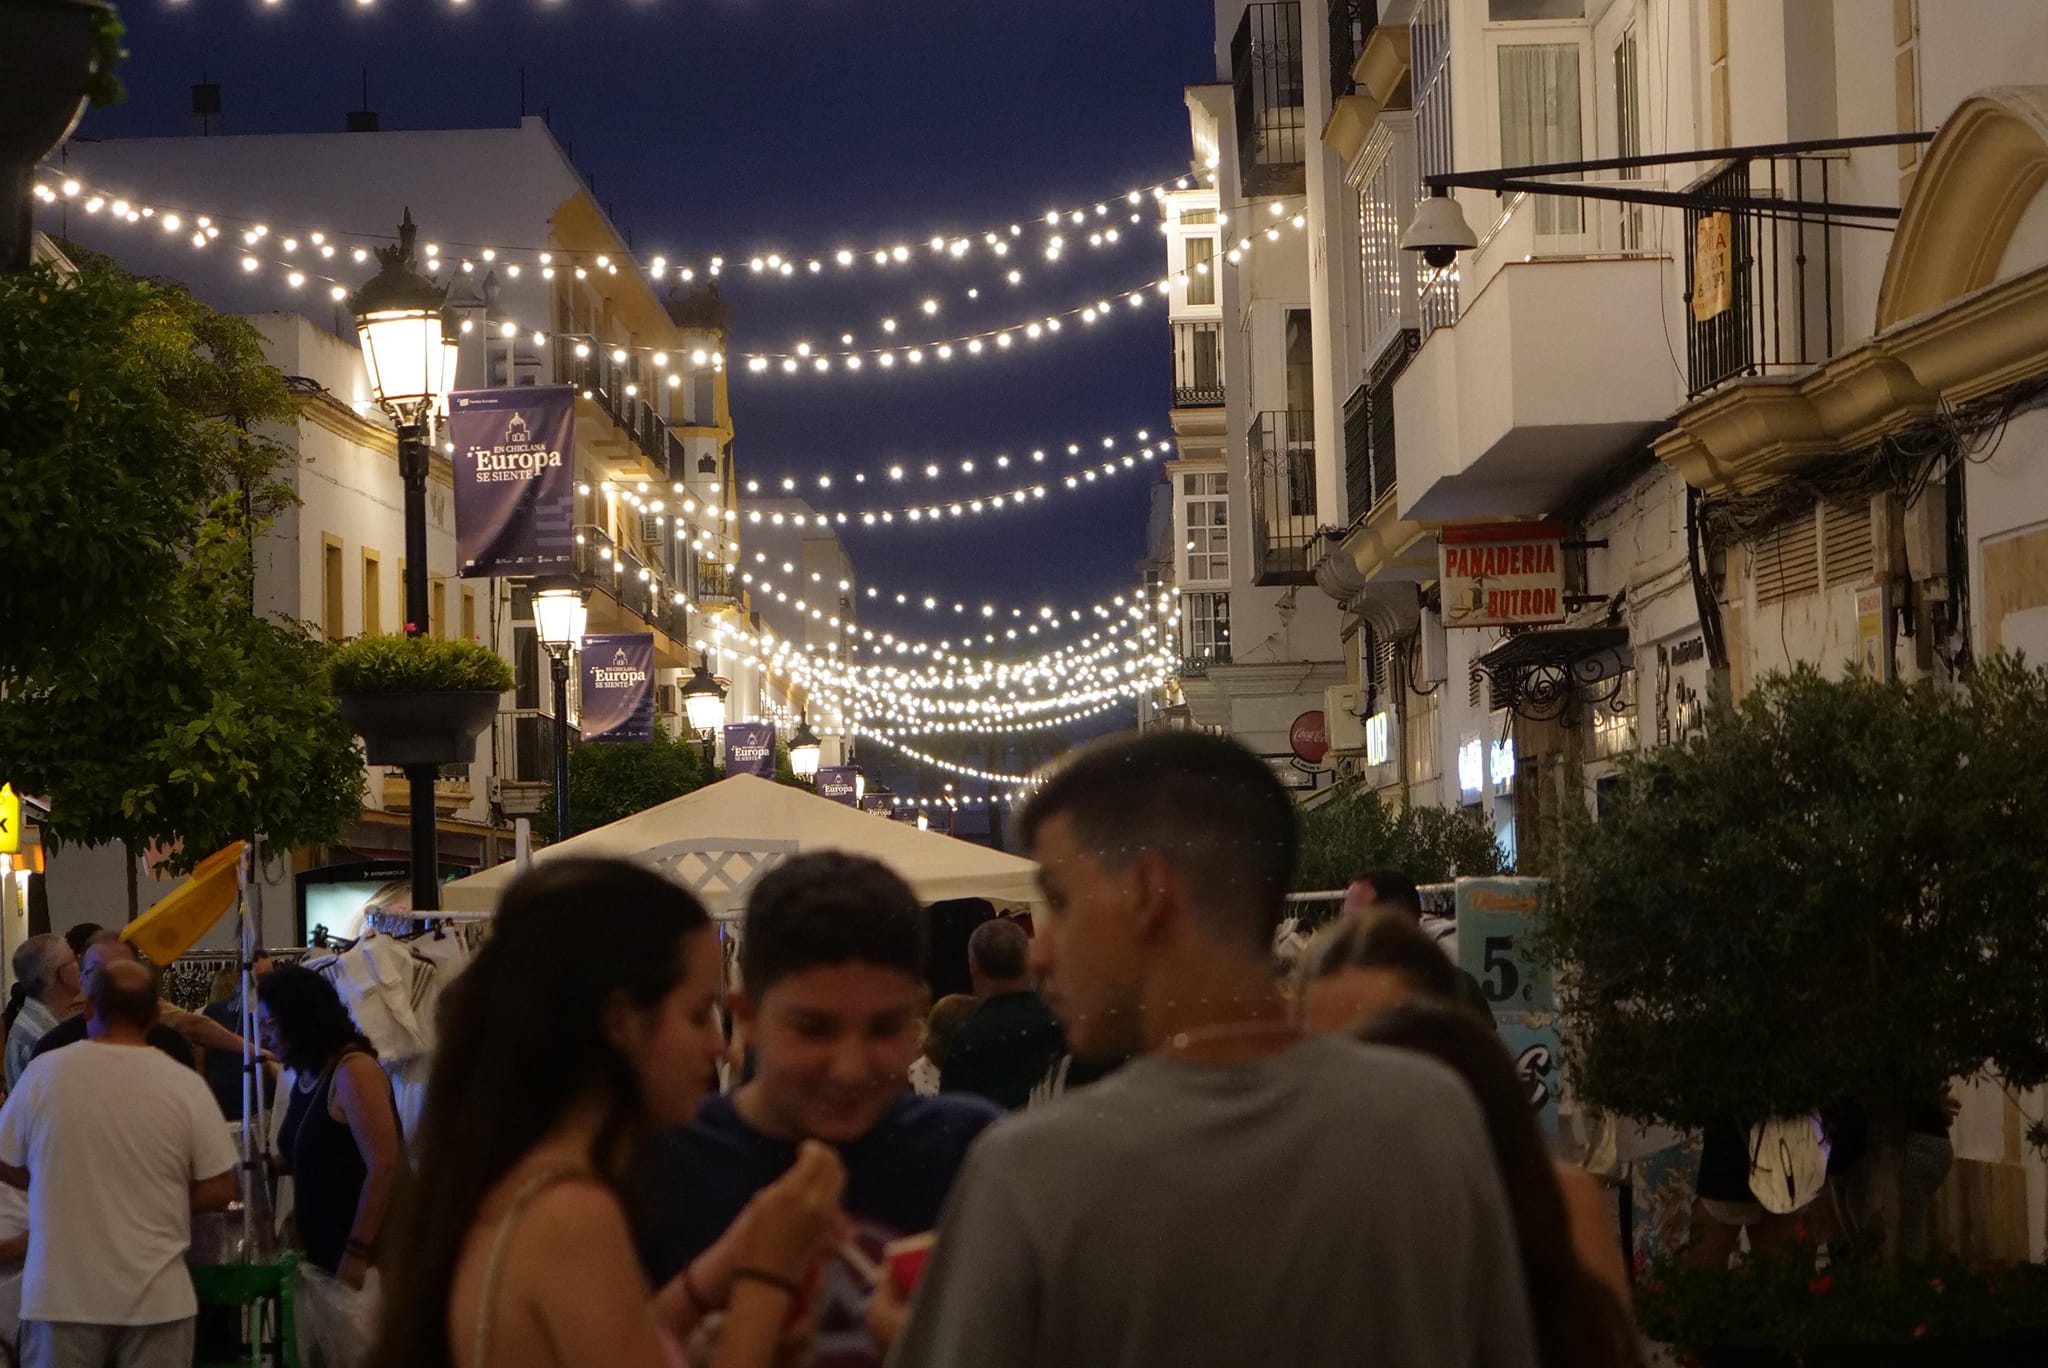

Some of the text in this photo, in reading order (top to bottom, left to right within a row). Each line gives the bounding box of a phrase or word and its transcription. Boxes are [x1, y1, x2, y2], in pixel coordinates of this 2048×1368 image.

[494, 443, 546, 454] EN CHICLANA
[475, 450, 562, 475] Europa
[476, 470, 533, 483] SE SIENTE
[1446, 544, 1555, 578] PANADERIA
[1487, 588, 1557, 618] BUTRON
[595, 669, 646, 686] Europa
[1294, 728, 1325, 743] Coca-Co
[735, 747, 770, 760] Europa
[825, 786, 853, 795] Europa
[1482, 935, 1519, 1002] 5
